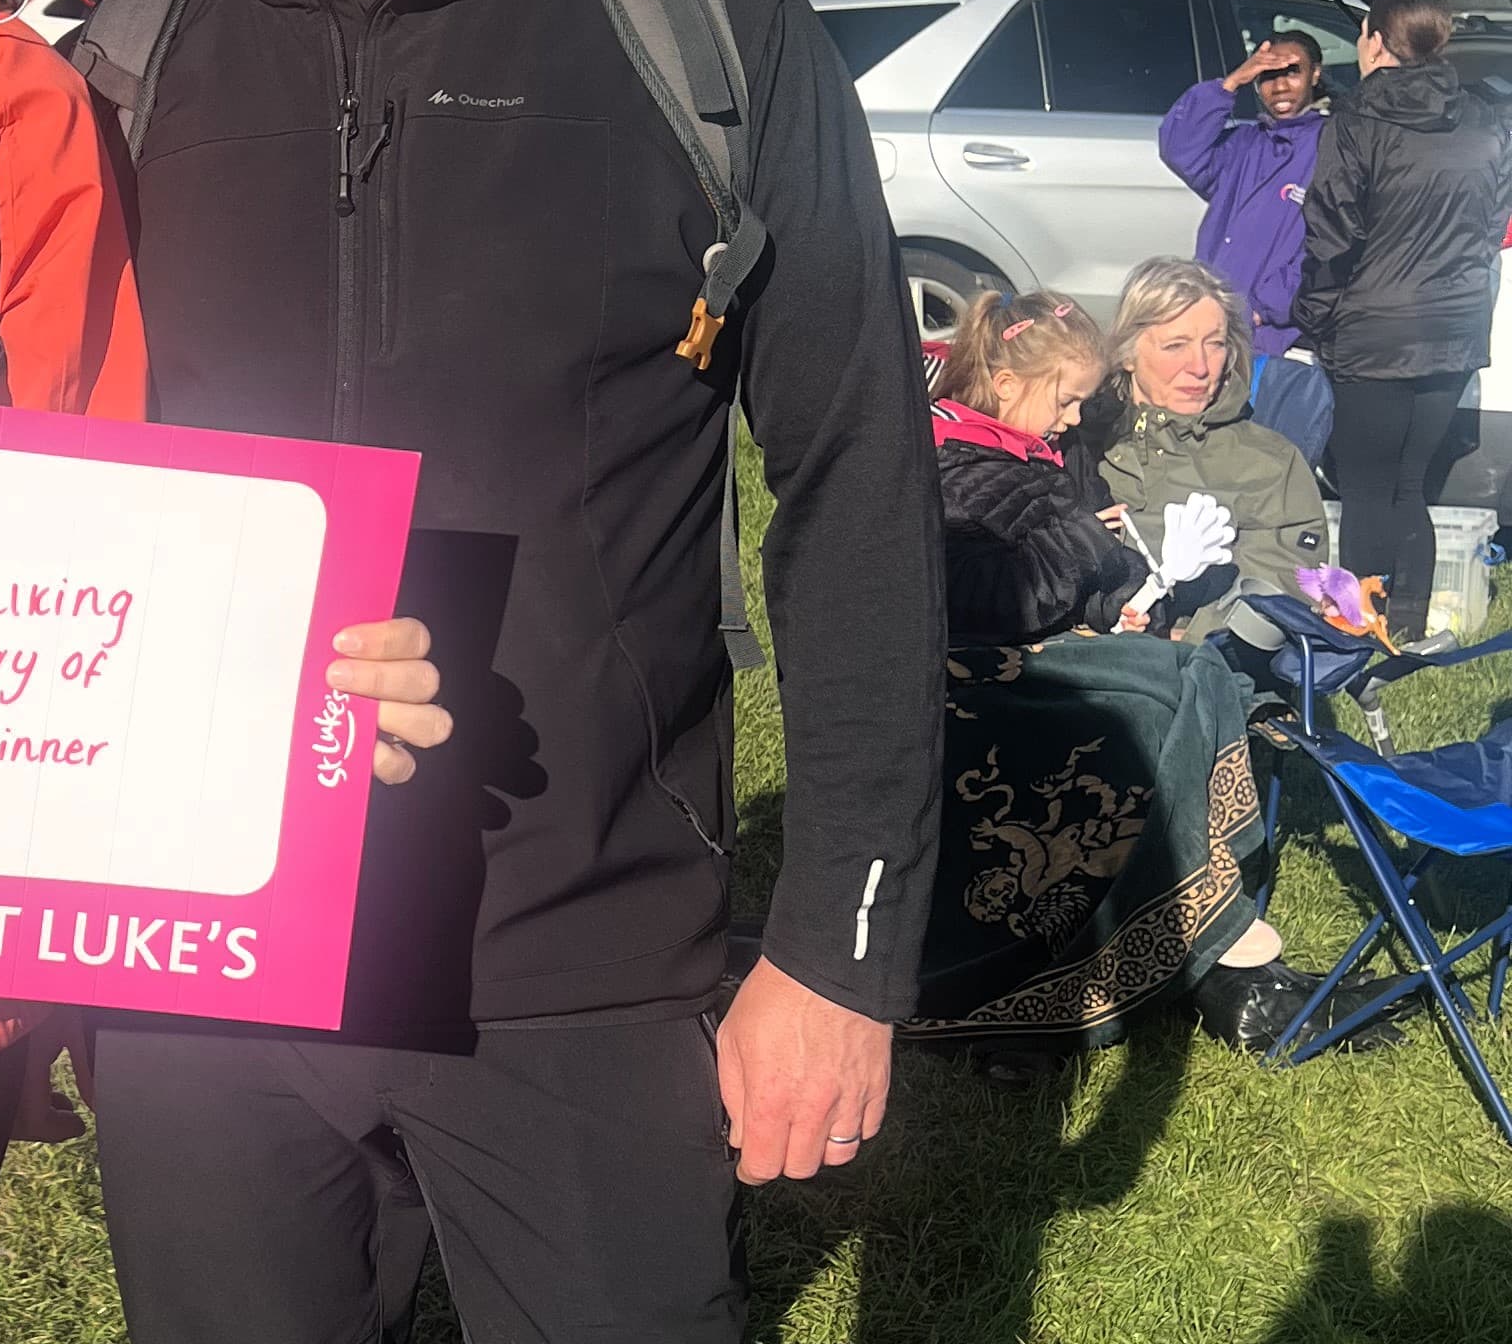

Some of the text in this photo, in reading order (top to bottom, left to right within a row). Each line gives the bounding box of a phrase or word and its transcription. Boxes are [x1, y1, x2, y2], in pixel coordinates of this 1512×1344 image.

[457, 93, 525, 109] Quechua
[60, 650, 110, 690] of
[37, 908, 257, 980] LUKE'S
